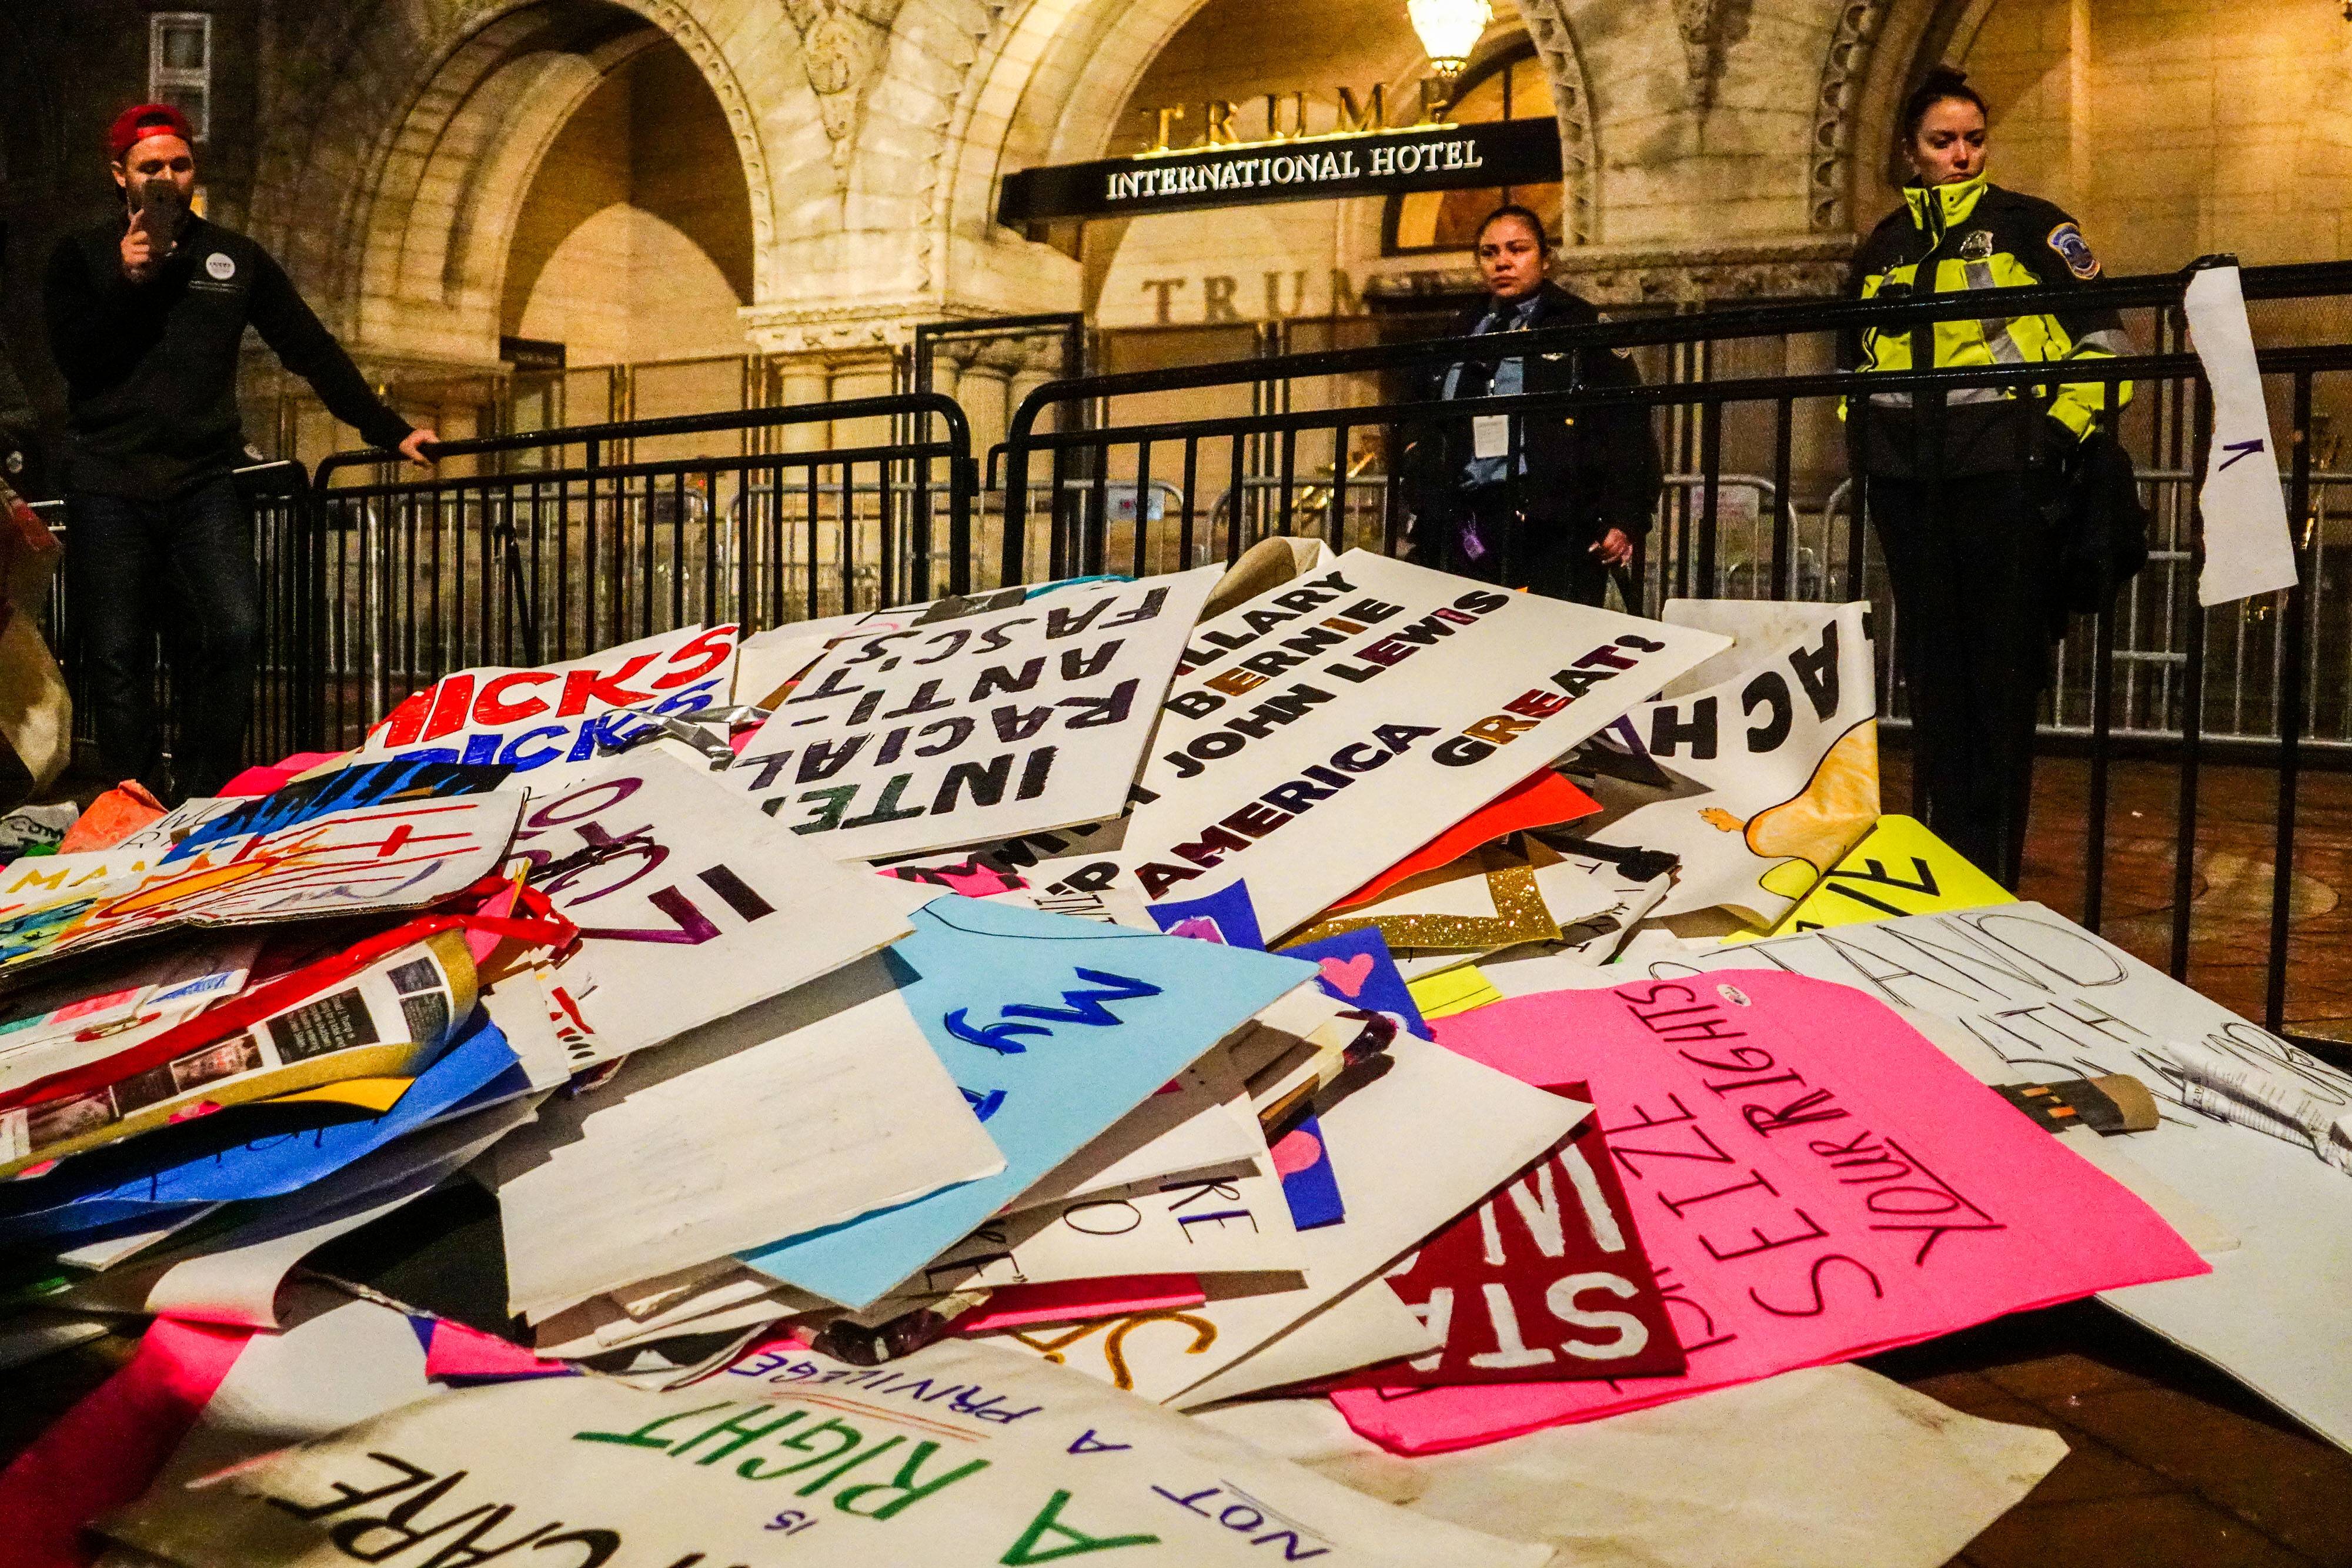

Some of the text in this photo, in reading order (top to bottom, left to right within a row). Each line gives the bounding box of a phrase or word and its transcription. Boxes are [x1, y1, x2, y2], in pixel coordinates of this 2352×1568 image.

[1106, 139, 1484, 201] INTERNATIONAL HOTEL
[1162, 597, 1406, 721] BERNIE
[1176, 570, 1358, 676] LLARY
[393, 678, 724, 773] ICKS
[733, 678, 1141, 791] RACIAL
[1164, 590, 1509, 779] JOHN LEWIS
[1650, 619, 1840, 760] ACH
[761, 746, 1058, 835] INTE
[1135, 723, 1441, 901] AMERICA
[1614, 984, 2007, 1267] YOUR RIGHTS
[1606, 1092, 1884, 1316] SEIZE
[1405, 1271, 1649, 1373] STA
[572, 1400, 1162, 1567] A RIGHT
[1066, 1429, 1134, 1456] A
[1150, 1482, 1331, 1563] NOT
